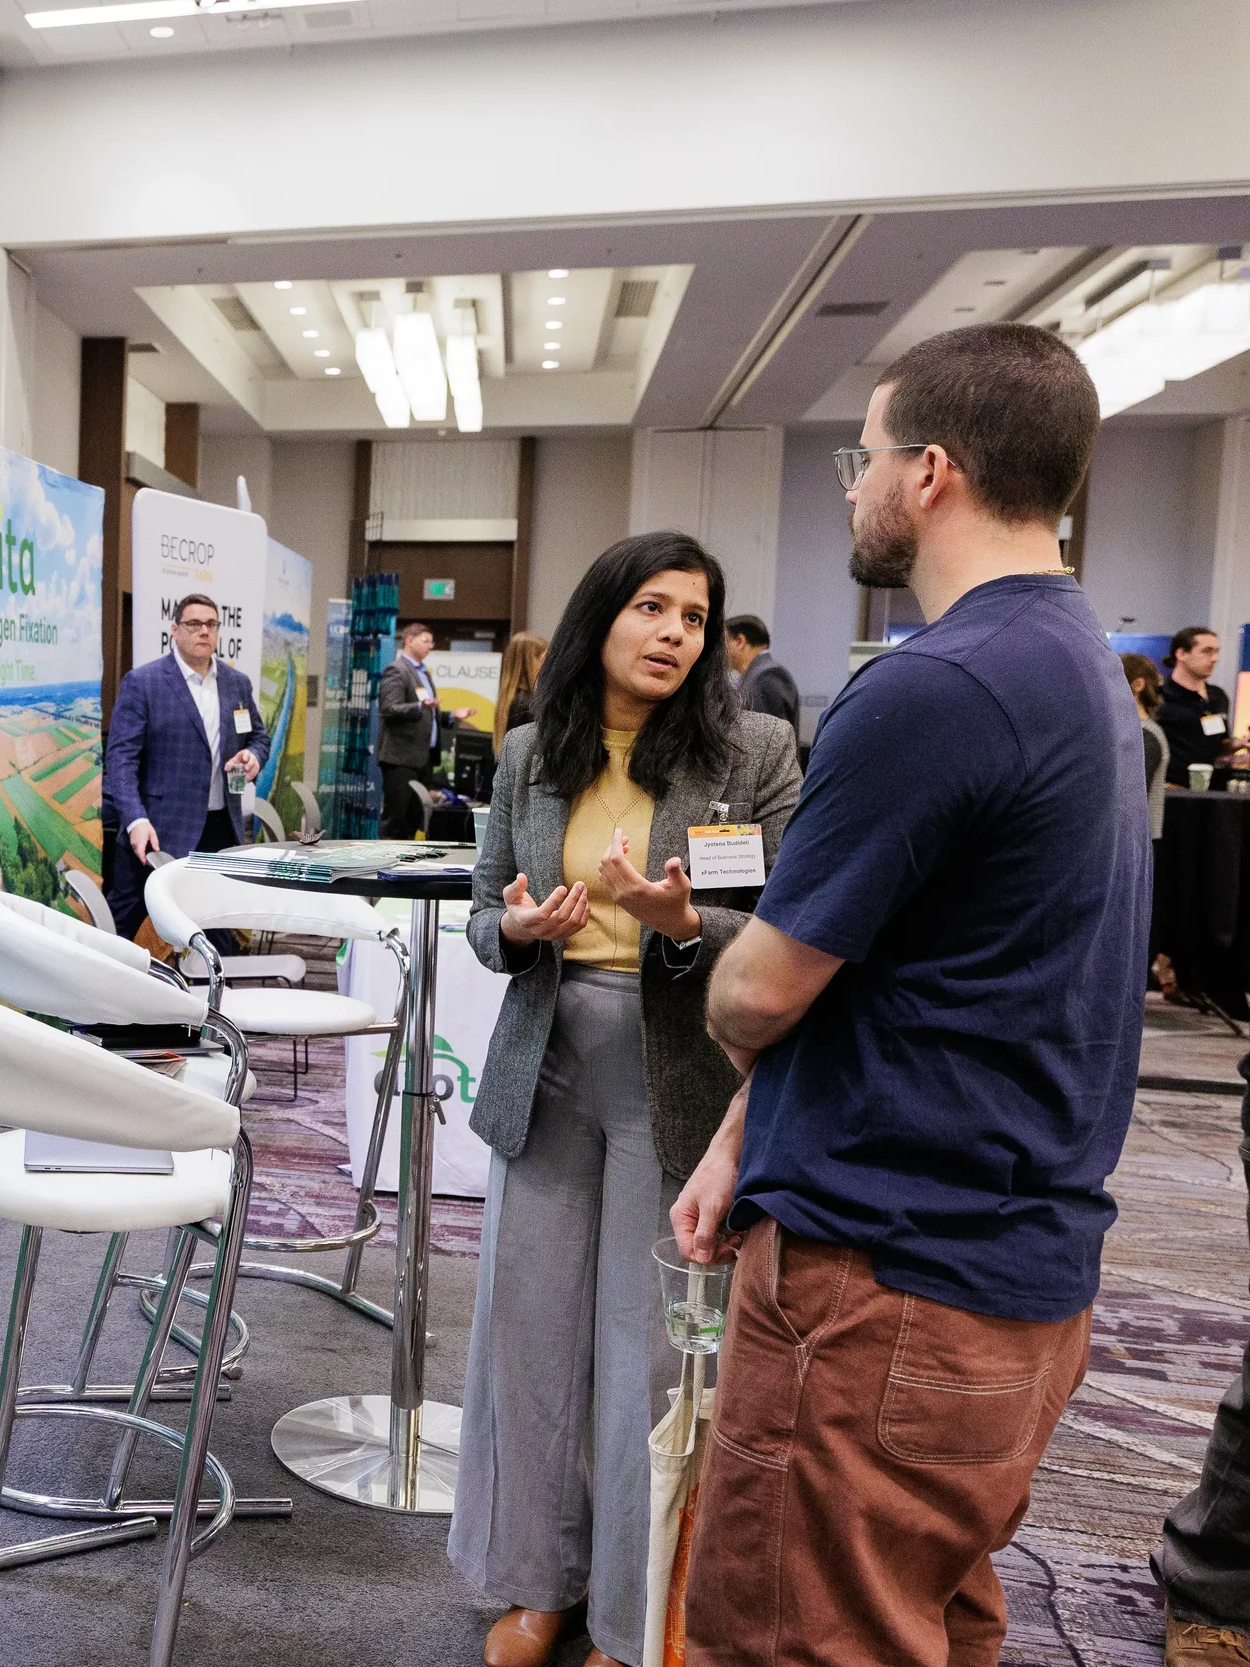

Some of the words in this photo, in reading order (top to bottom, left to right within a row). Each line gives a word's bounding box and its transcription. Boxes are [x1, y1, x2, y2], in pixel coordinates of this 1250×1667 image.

[161, 535, 214, 566] BECROP
[221, 605, 242, 628] THE
[19, 613, 58, 645] Fixation
[228, 638, 242, 659] OF
[15, 659, 37, 682] Time.
[436, 664, 499, 680] CLAUSE
[719, 868, 756, 876] Technologies
